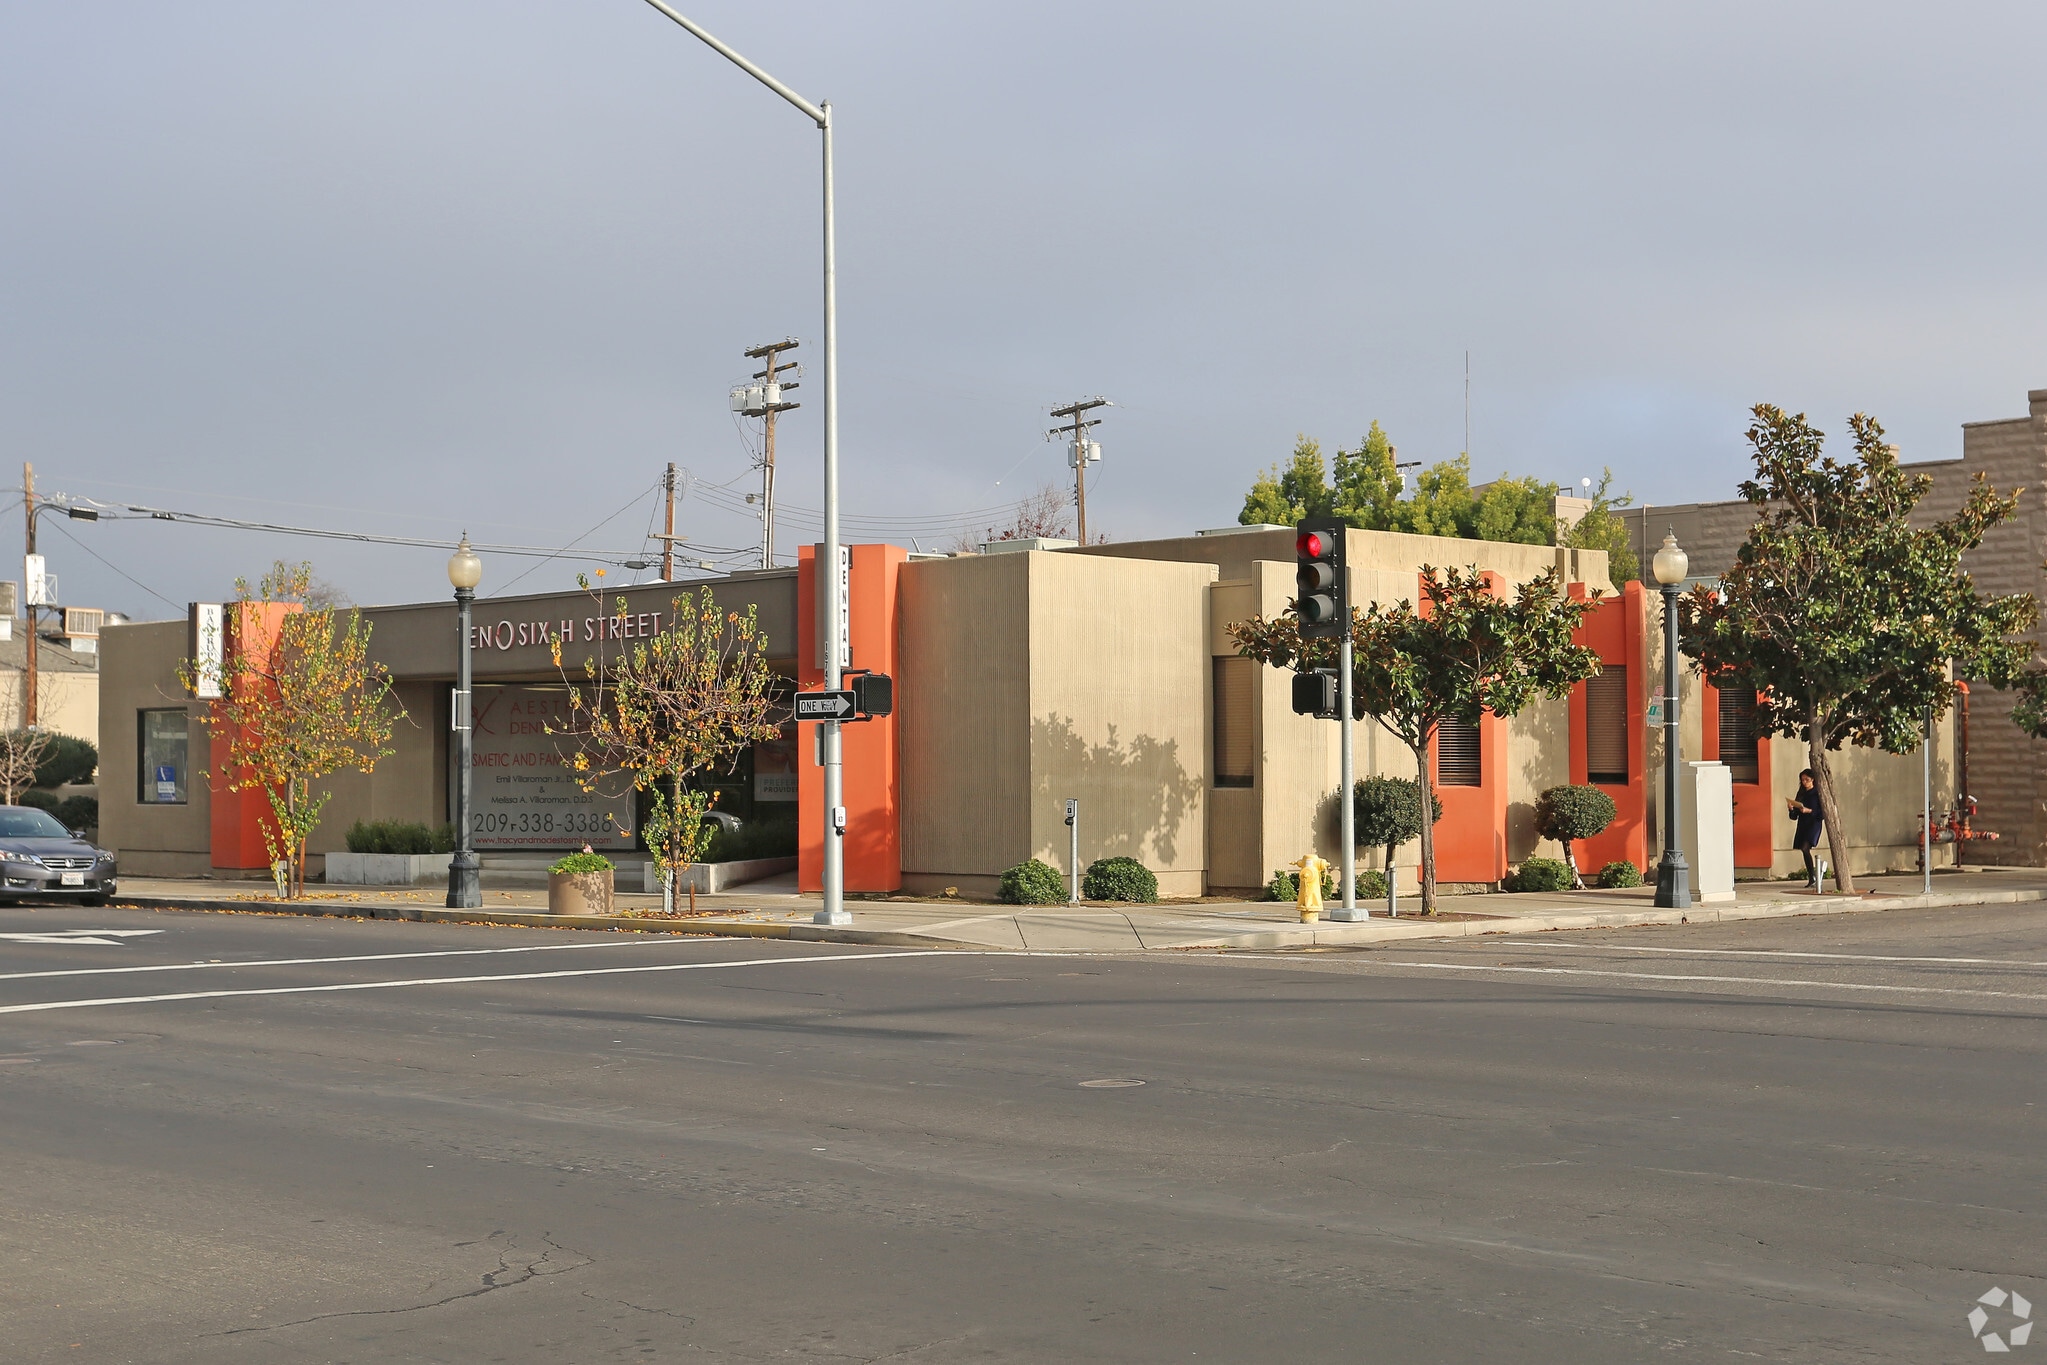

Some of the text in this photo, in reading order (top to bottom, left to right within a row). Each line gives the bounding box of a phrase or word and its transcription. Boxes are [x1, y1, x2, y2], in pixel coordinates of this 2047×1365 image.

[457, 612, 662, 650] ENOSIX H STREET
[800, 700, 838, 712] ONE WY
[455, 752, 509, 767] SMETIC
[512, 752, 536, 767] AND
[496, 775, 511, 783] Emil
[512, 775, 552, 783] Villaroman
[491, 796, 518, 804] Melissa
[519, 796, 528, 804] A.
[474, 813, 612, 833] 209-338-3388
[475, 836, 612, 845] www.tracyandmodestosmiles.com
